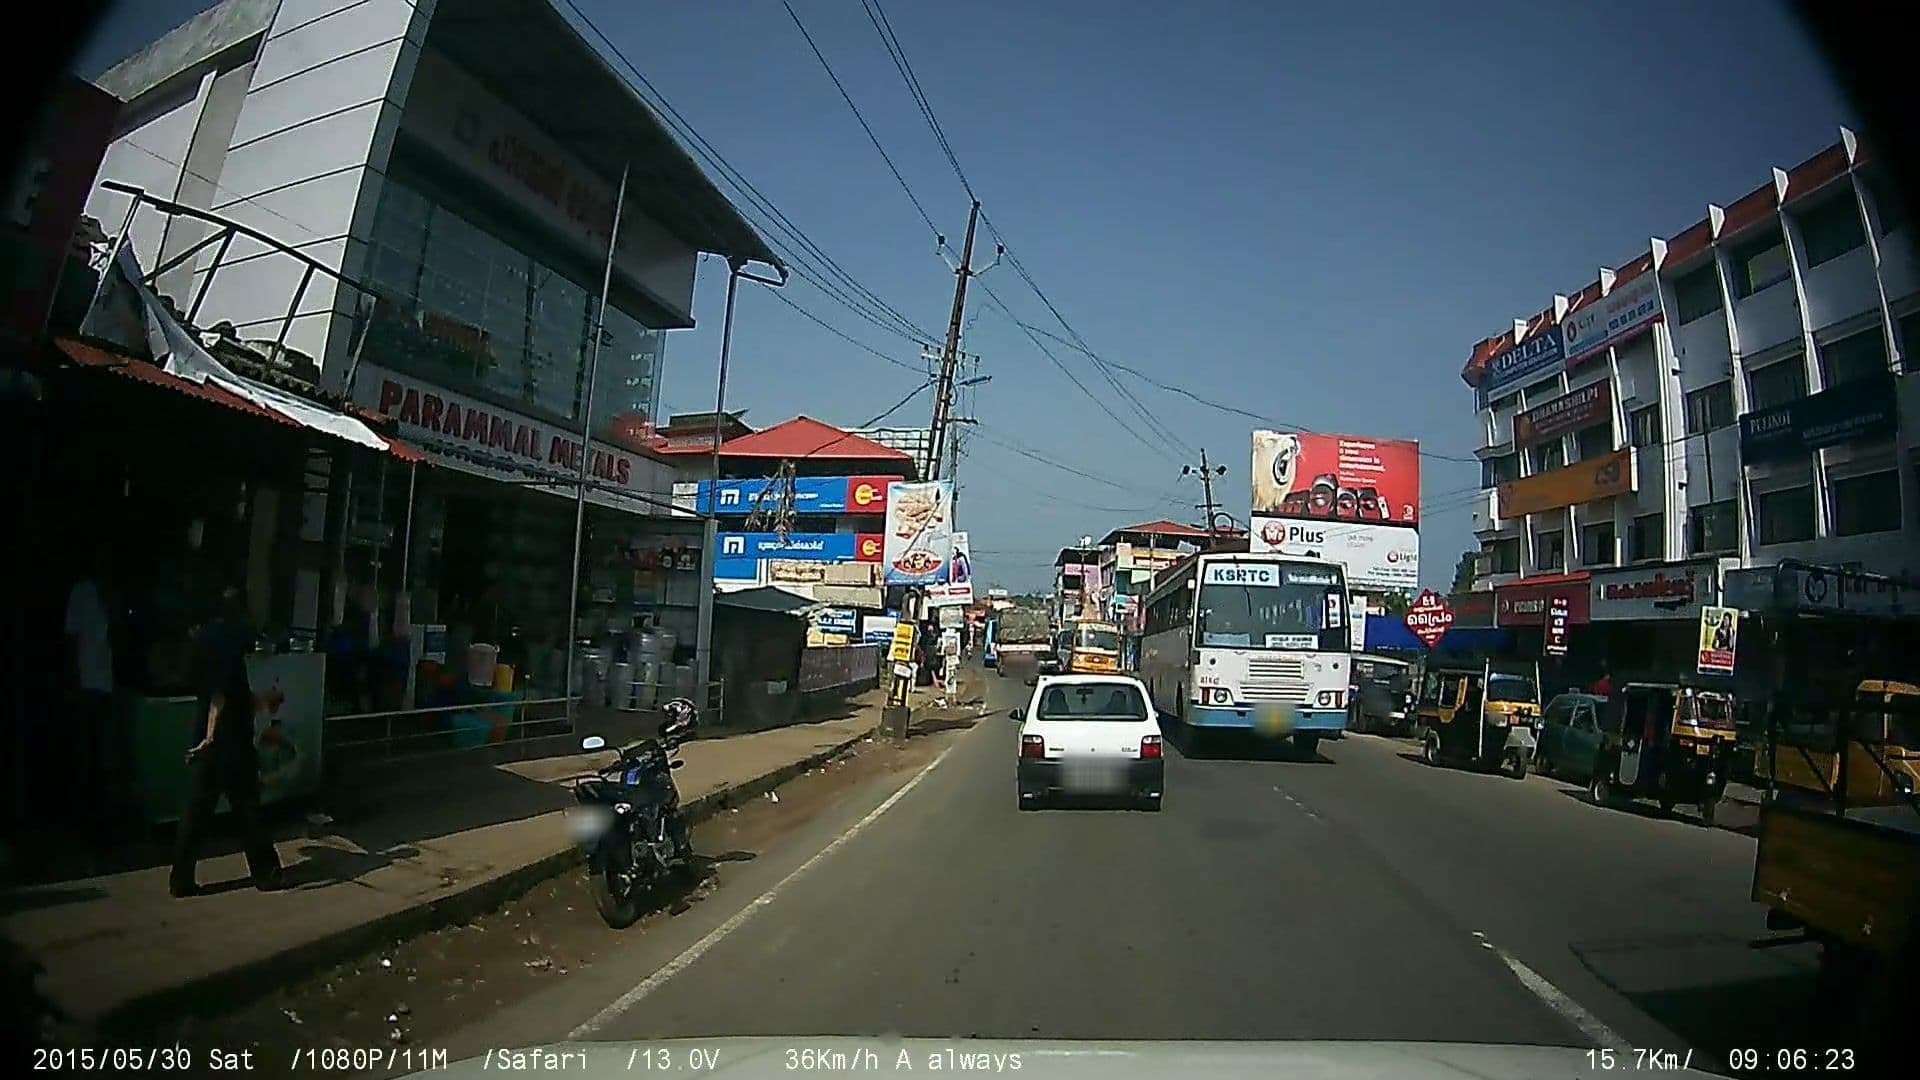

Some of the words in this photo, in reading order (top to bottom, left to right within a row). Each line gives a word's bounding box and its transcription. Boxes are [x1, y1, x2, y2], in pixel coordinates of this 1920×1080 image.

[1502, 333, 1557, 369] DELTA
[378, 379, 544, 462] PARAMMAL
[548, 435, 631, 485] METALS
[1289, 526, 1325, 543] Plus
[1213, 569, 1271, 583] KSRTC
